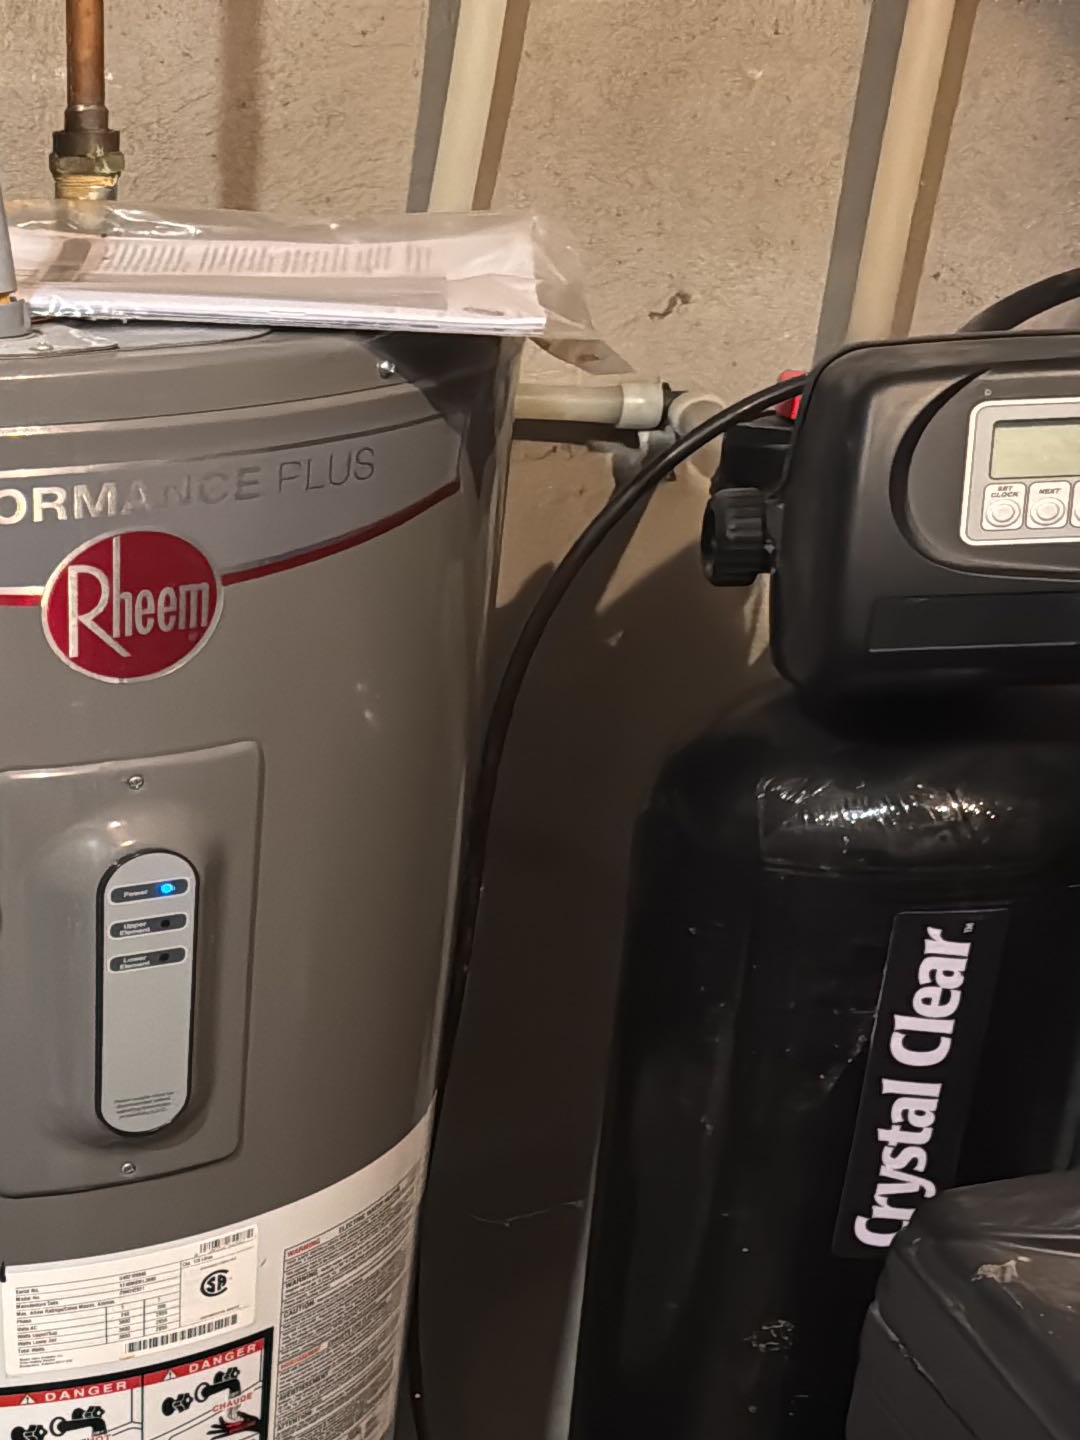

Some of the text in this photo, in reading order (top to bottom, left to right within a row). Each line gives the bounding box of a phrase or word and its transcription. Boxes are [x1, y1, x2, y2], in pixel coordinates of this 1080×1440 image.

[277, 446, 376, 493] PLUS
[66, 535, 211, 659] Rheem
[123, 889, 149, 898] Power
[123, 921, 148, 930] Upper
[853, 926, 972, 1248] Crystal Clear
[43, 1342, 258, 1402] DANGER DANGER
[211, 1393, 254, 1413] CHAUDE
